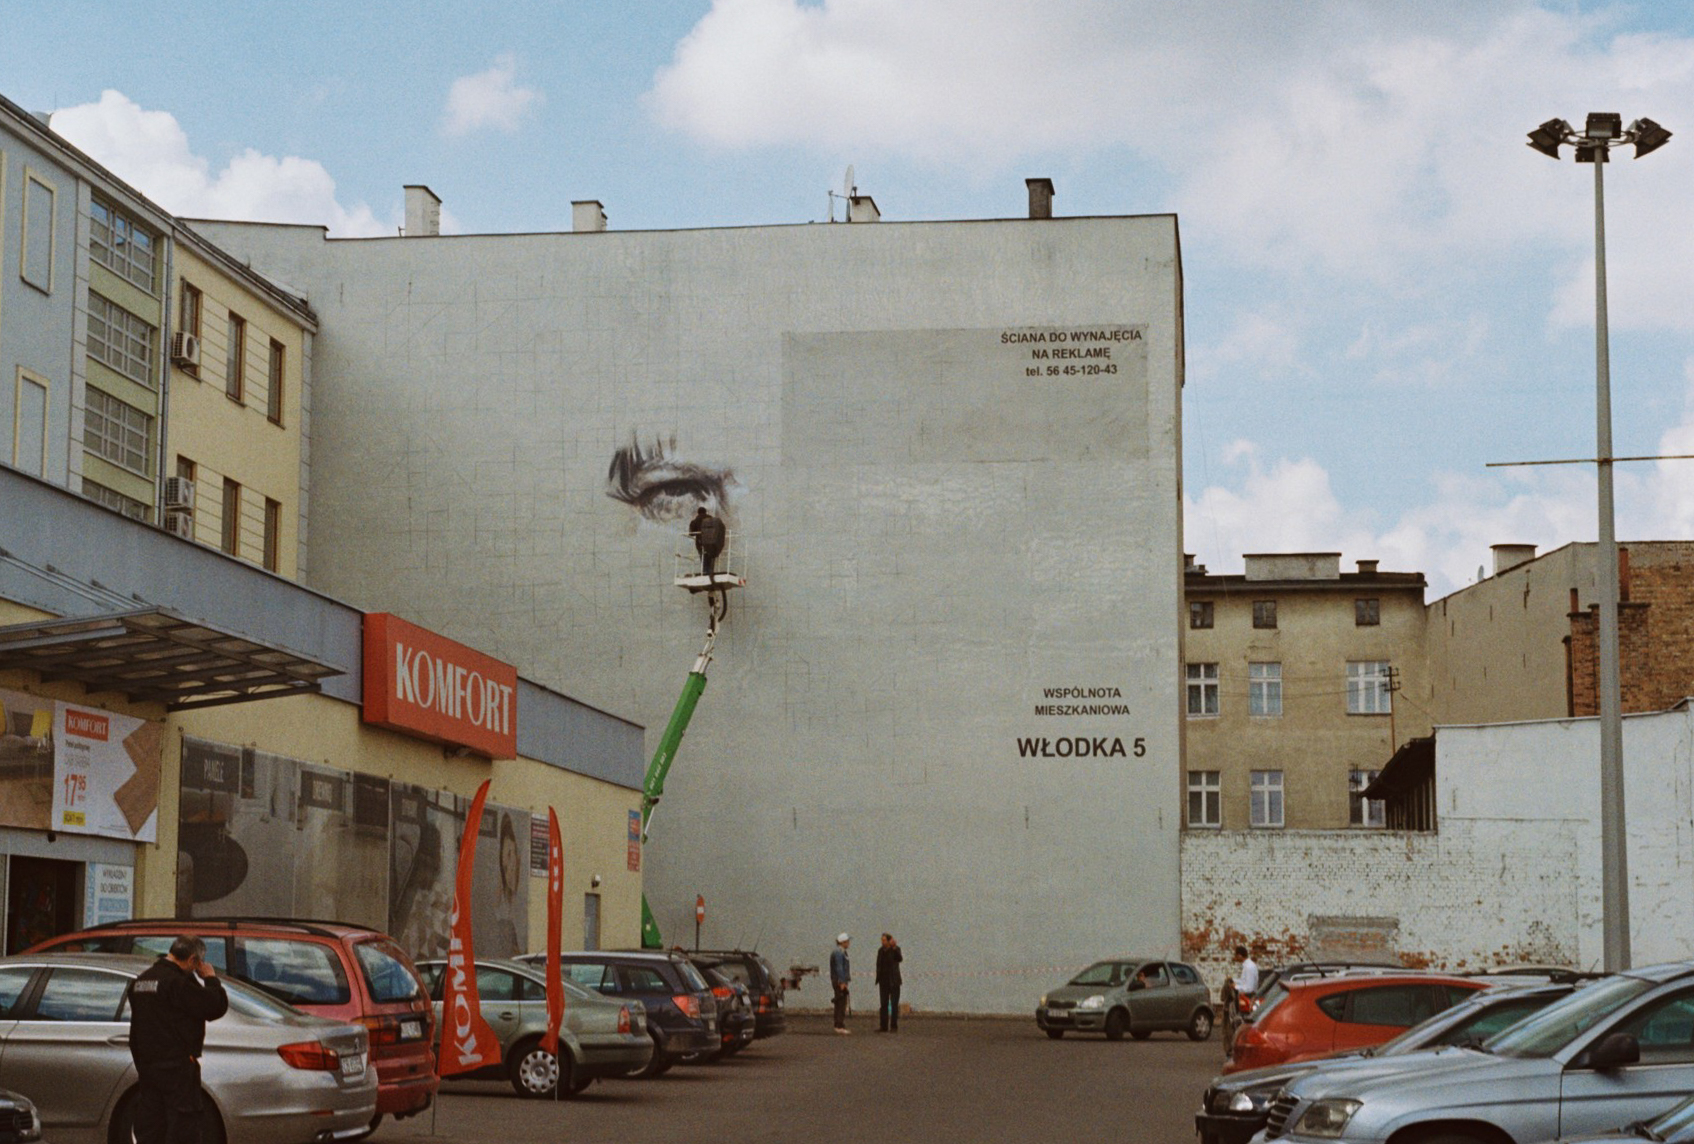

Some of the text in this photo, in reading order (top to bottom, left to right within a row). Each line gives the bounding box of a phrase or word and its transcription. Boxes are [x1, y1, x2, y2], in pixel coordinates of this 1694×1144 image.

[1001, 330, 1142, 344] ŚCIANA DO WYNAJĘCIA
[1032, 347, 1111, 359] NA REKLAMĘ
[1025, 364, 1118, 377] tel. 56 45-120-43
[396, 642, 513, 736] KOMFORT
[1043, 686, 1122, 698] WSPÓLNOTA
[1034, 704, 1130, 716] MIESZKANIOWA
[68, 714, 107, 735] KOMFORT
[1017, 737, 1146, 757] WŁODKA 5
